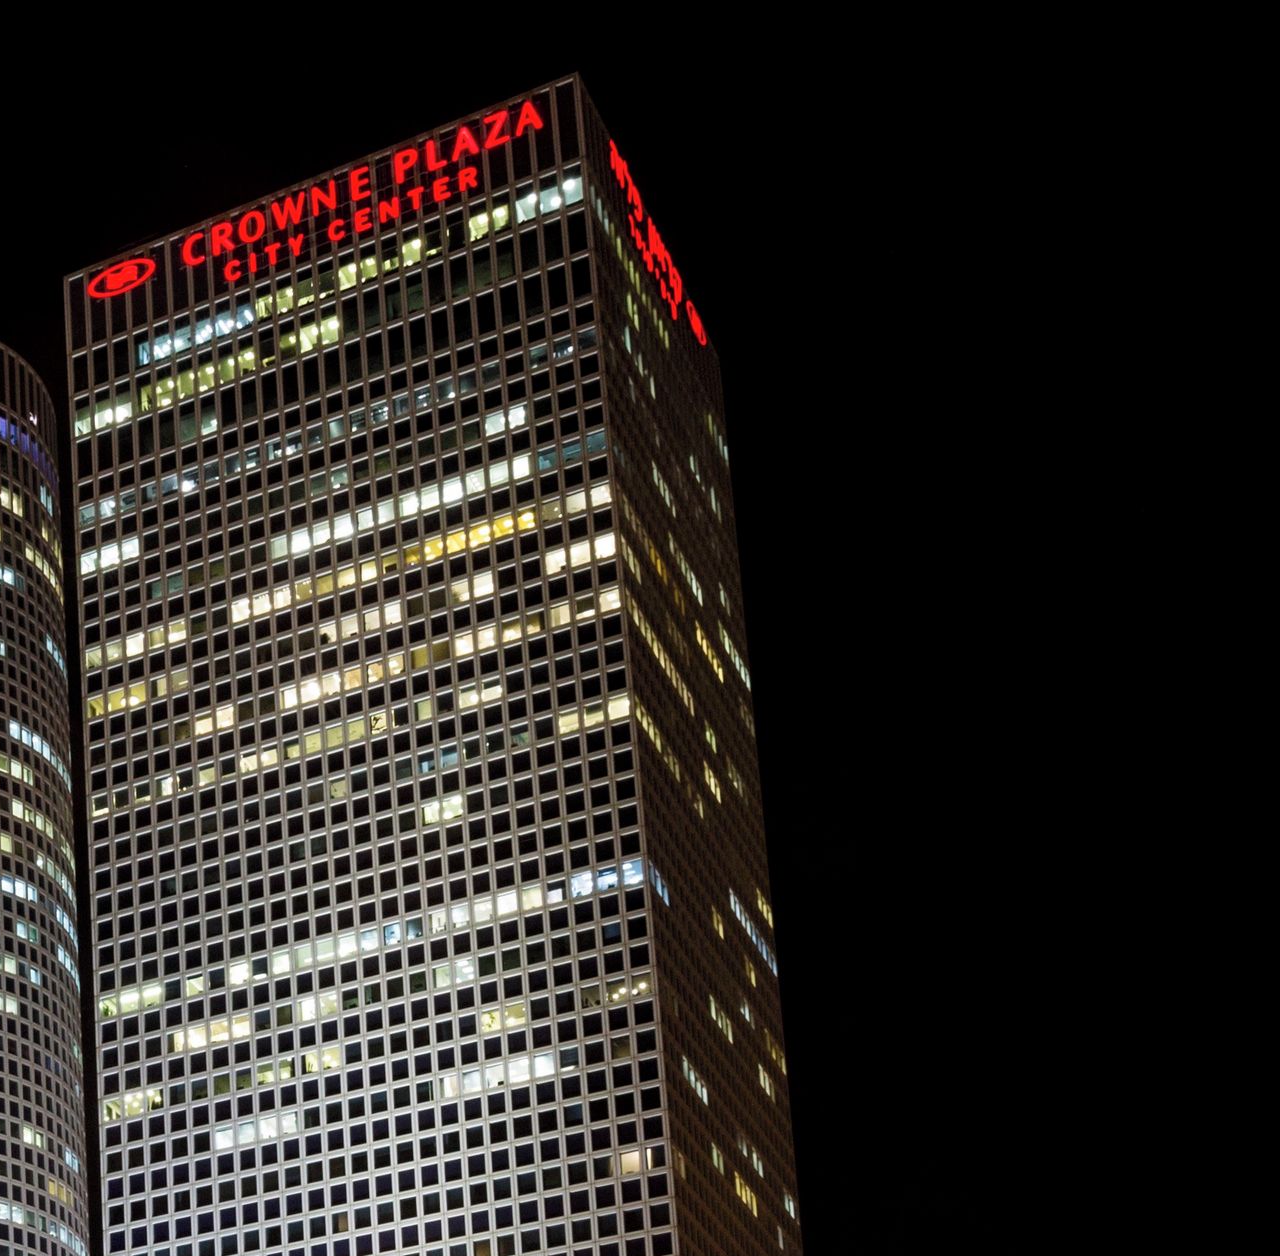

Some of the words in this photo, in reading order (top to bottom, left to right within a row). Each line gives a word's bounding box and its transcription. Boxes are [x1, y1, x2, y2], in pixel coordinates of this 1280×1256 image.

[182, 165, 372, 268] CROWNE
[393, 101, 543, 184] PLAZA
[224, 234, 305, 283] CITY
[328, 167, 477, 244] CENTER
